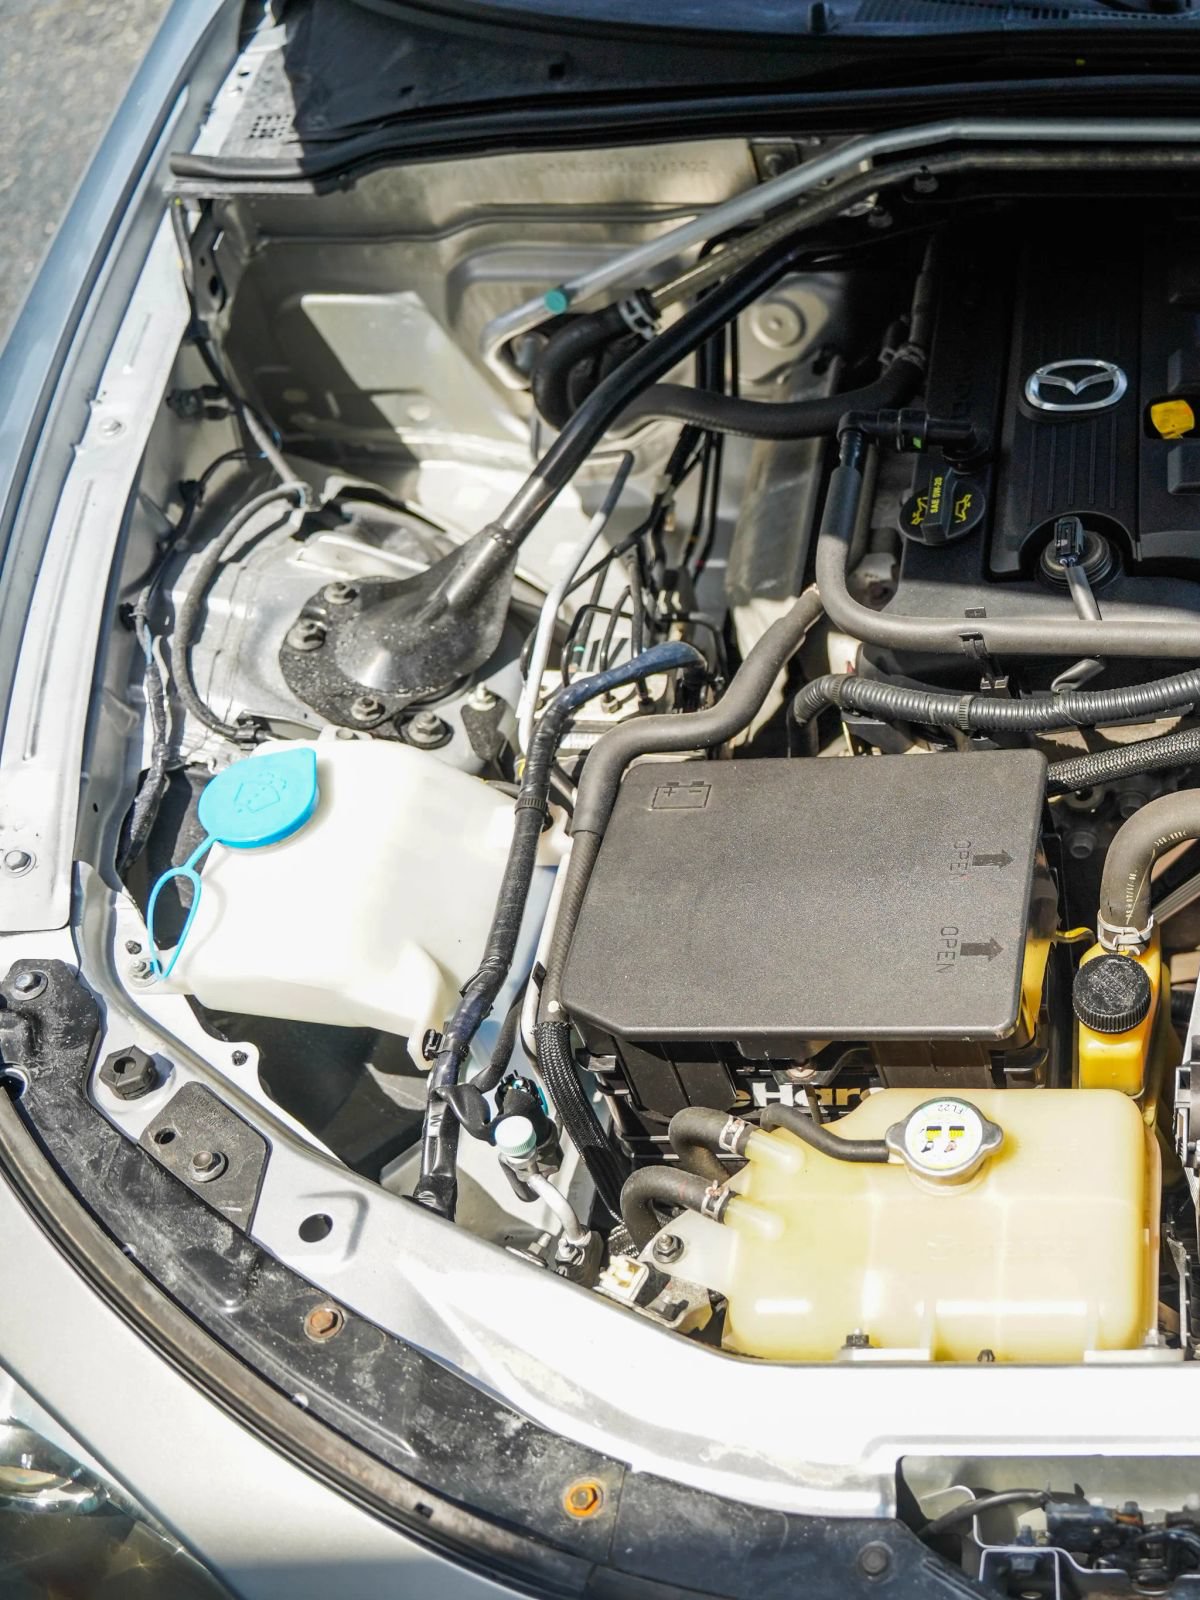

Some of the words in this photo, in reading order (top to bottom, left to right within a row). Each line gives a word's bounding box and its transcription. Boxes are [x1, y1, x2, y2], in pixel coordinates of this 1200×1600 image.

[930, 499, 940, 513] SAE
[936, 926, 959, 973] OPEN
[937, 1104, 964, 1114] FL22
